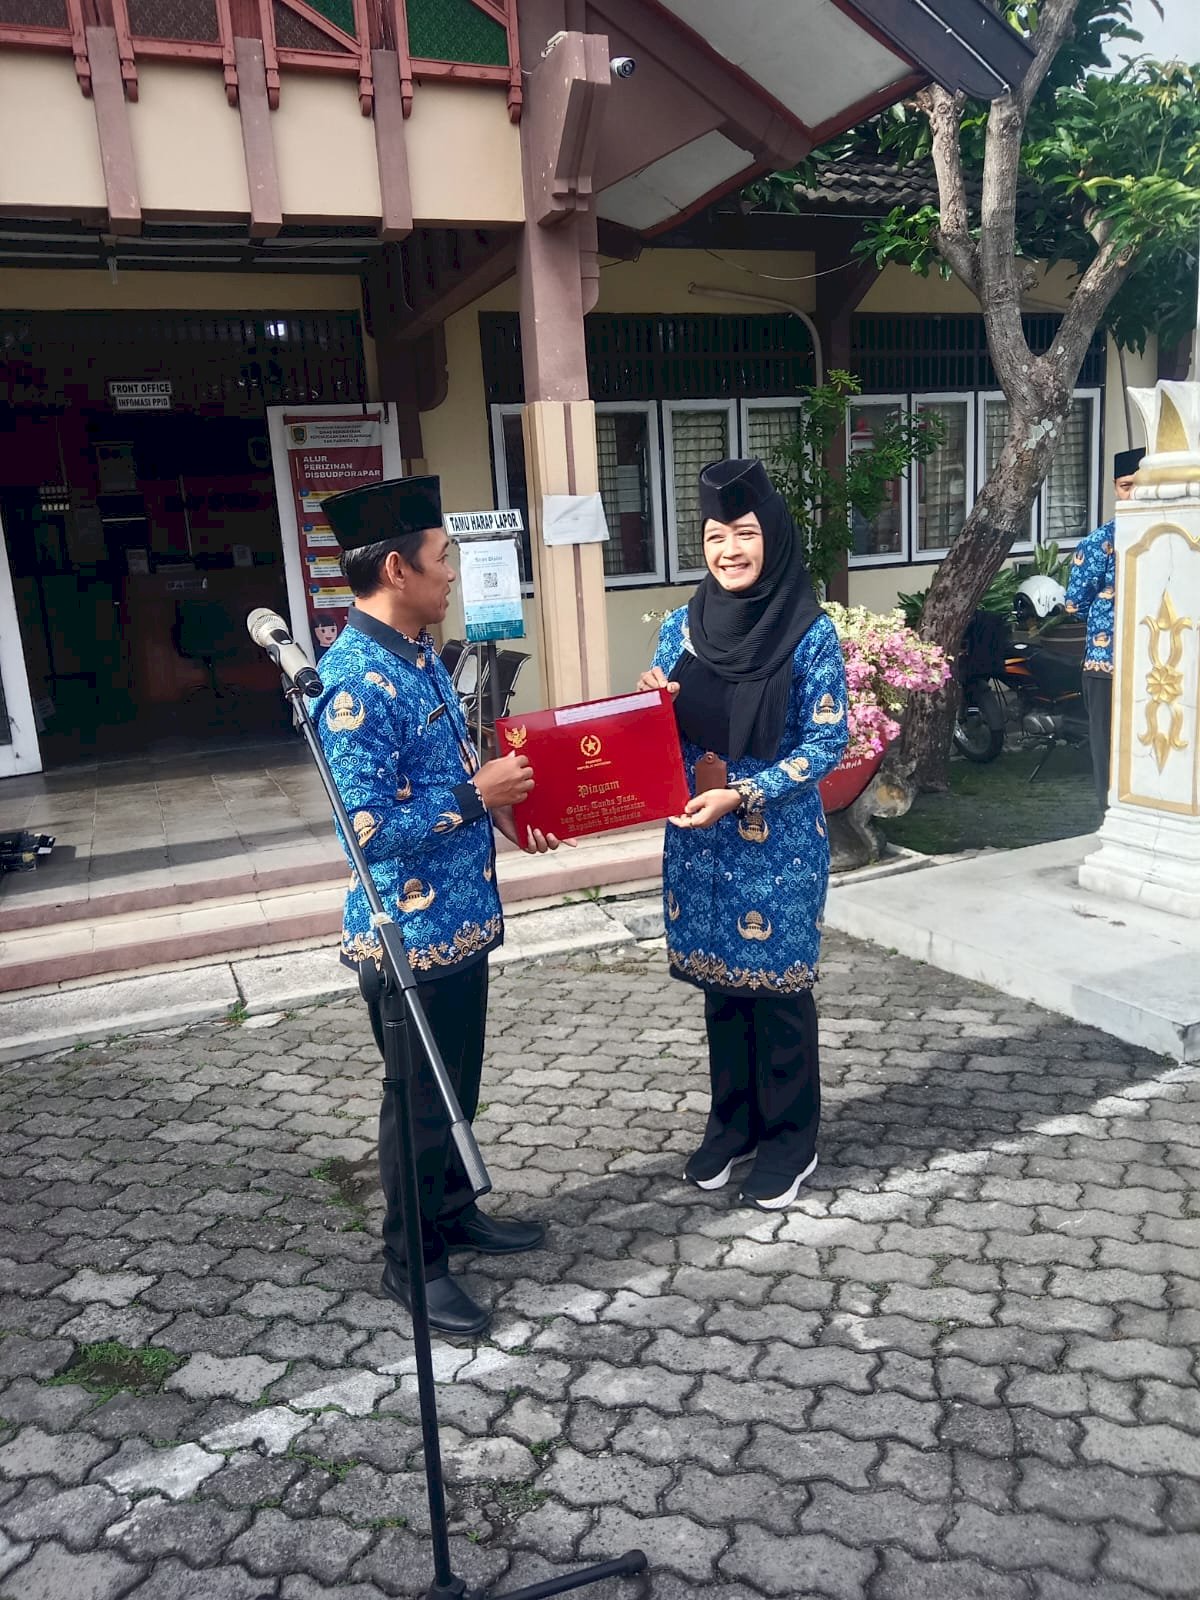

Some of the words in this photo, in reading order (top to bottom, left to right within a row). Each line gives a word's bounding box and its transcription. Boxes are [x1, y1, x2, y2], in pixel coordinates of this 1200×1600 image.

[111, 383, 139, 394] FRONT
[141, 383, 170, 393] OFFICE
[303, 455, 328, 463] ALUR
[304, 463, 353, 471] PERIZINAN
[305, 470, 381, 479] DISBUDPORAPAR
[449, 516, 470, 531] TAMU
[470, 514, 493, 530] HARAP
[494, 512, 519, 529] LAPOR
[577, 780, 620, 798] Piagam
[591, 798, 615, 809] Tanda
